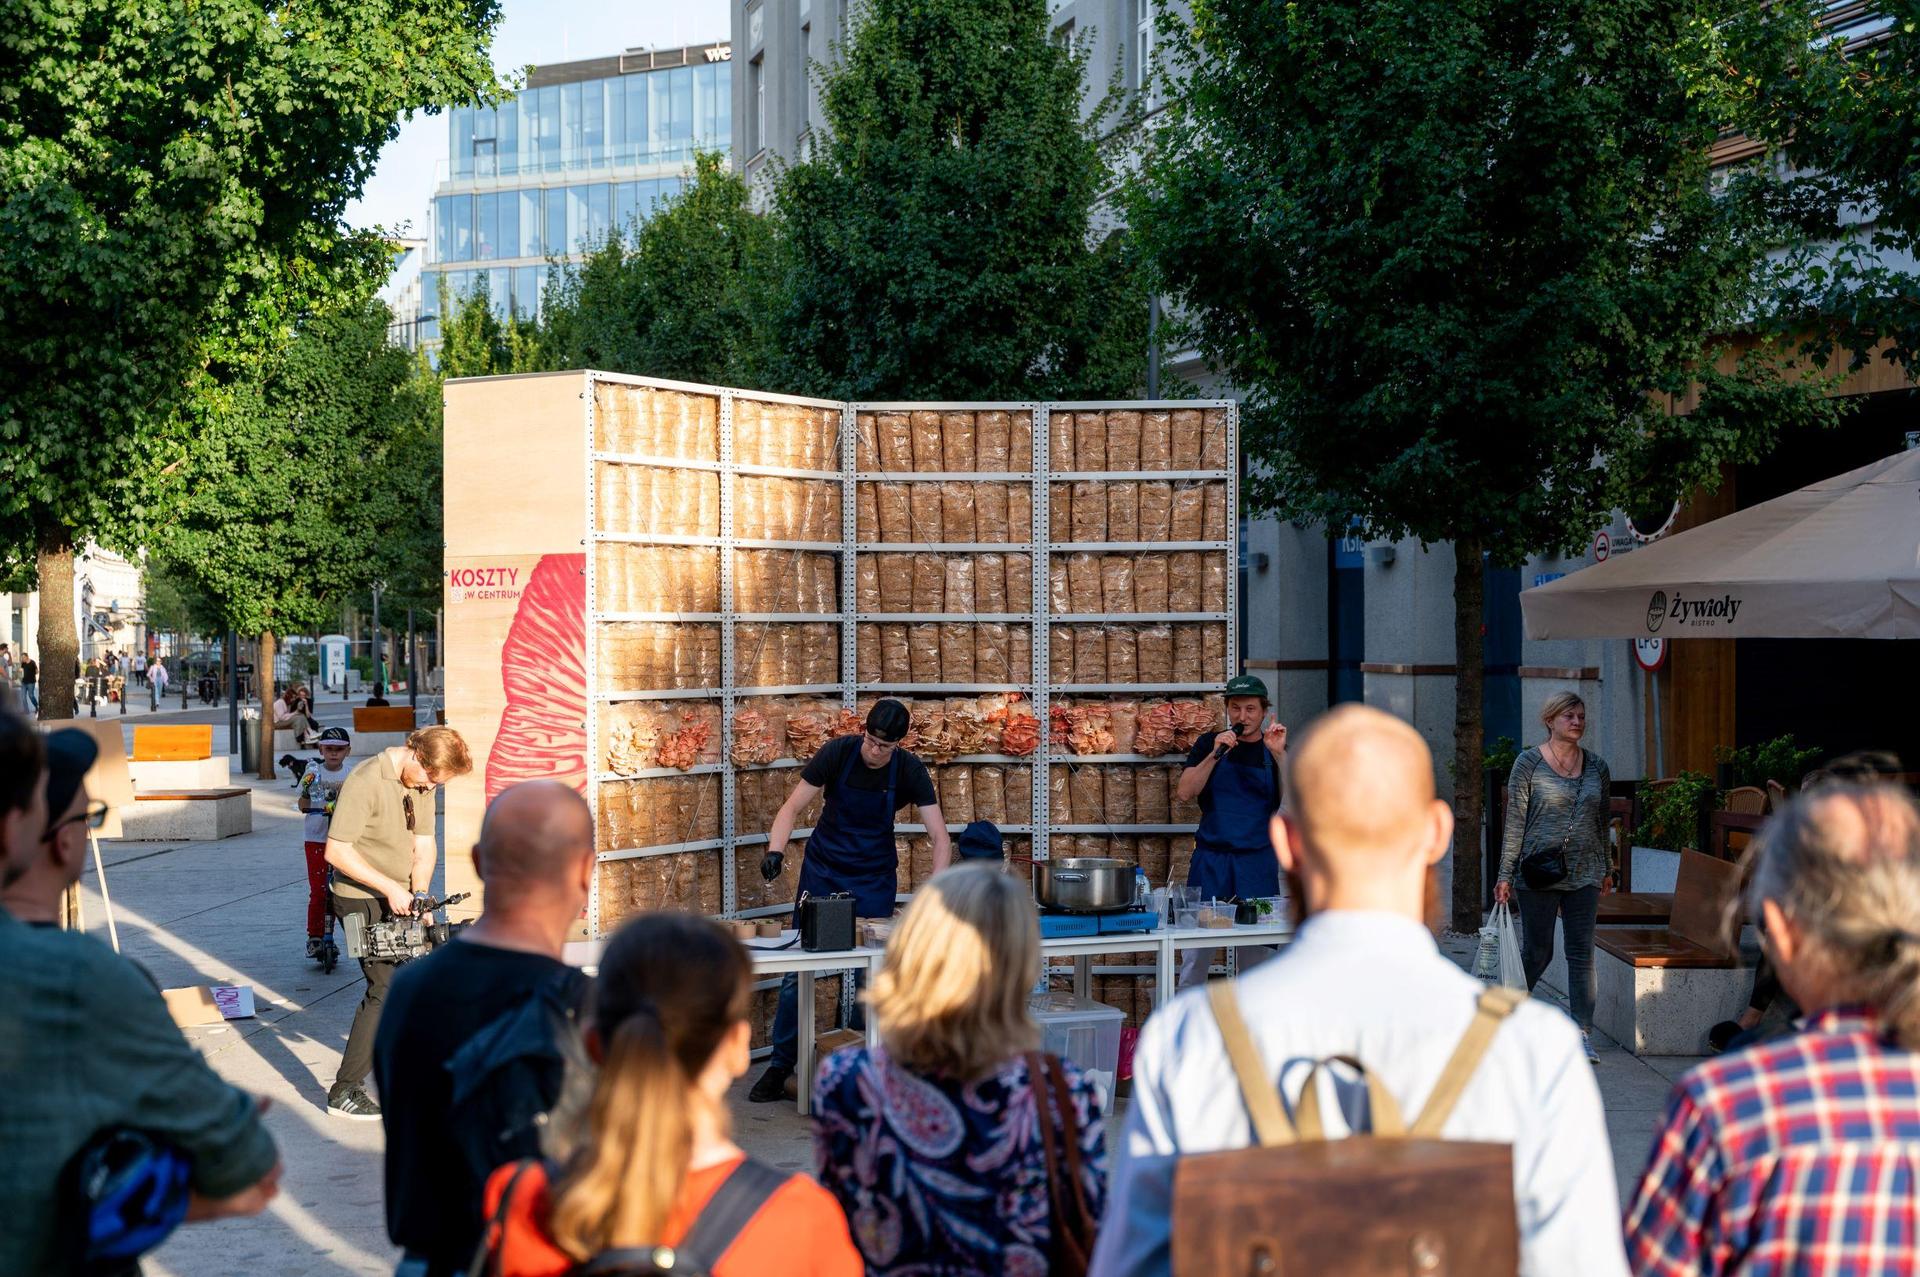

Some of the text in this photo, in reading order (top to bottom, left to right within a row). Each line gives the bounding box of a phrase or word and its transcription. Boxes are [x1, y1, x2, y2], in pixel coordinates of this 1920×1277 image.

[451, 568, 519, 587] KOSZTY
[477, 590, 520, 600] CENTRUM
[1669, 592, 1742, 624] Żywioły
